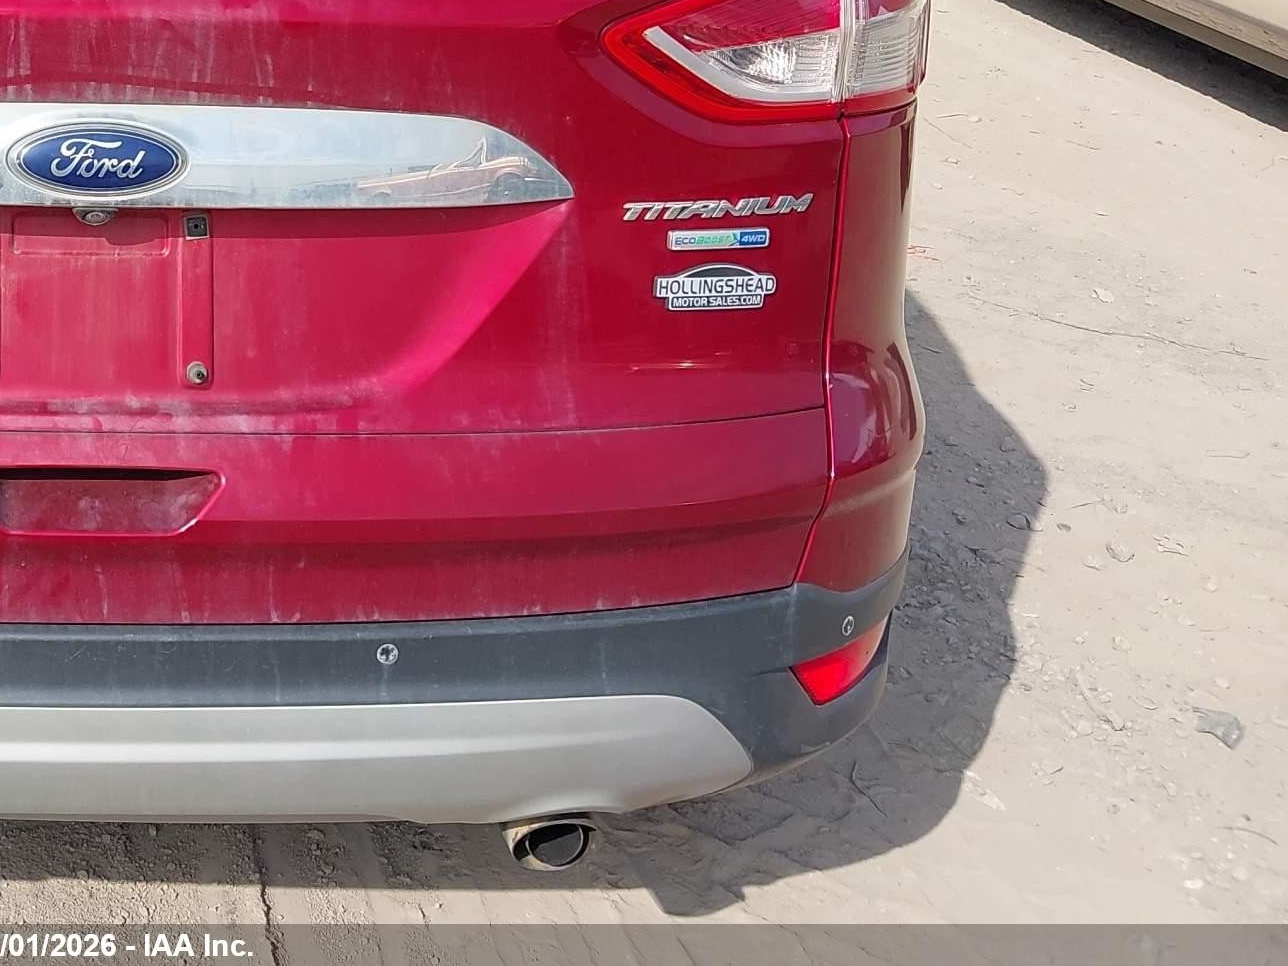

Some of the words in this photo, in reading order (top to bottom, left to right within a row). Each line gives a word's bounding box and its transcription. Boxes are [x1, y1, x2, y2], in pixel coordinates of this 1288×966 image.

[51, 138, 145, 179] Ford
[623, 193, 813, 220] TITANIUM
[741, 234, 766, 243] 4WD
[658, 277, 775, 295] HOLLINGSHEAD
[673, 296, 708, 307] MOTOR
[708, 294, 761, 305] SALES.COM
